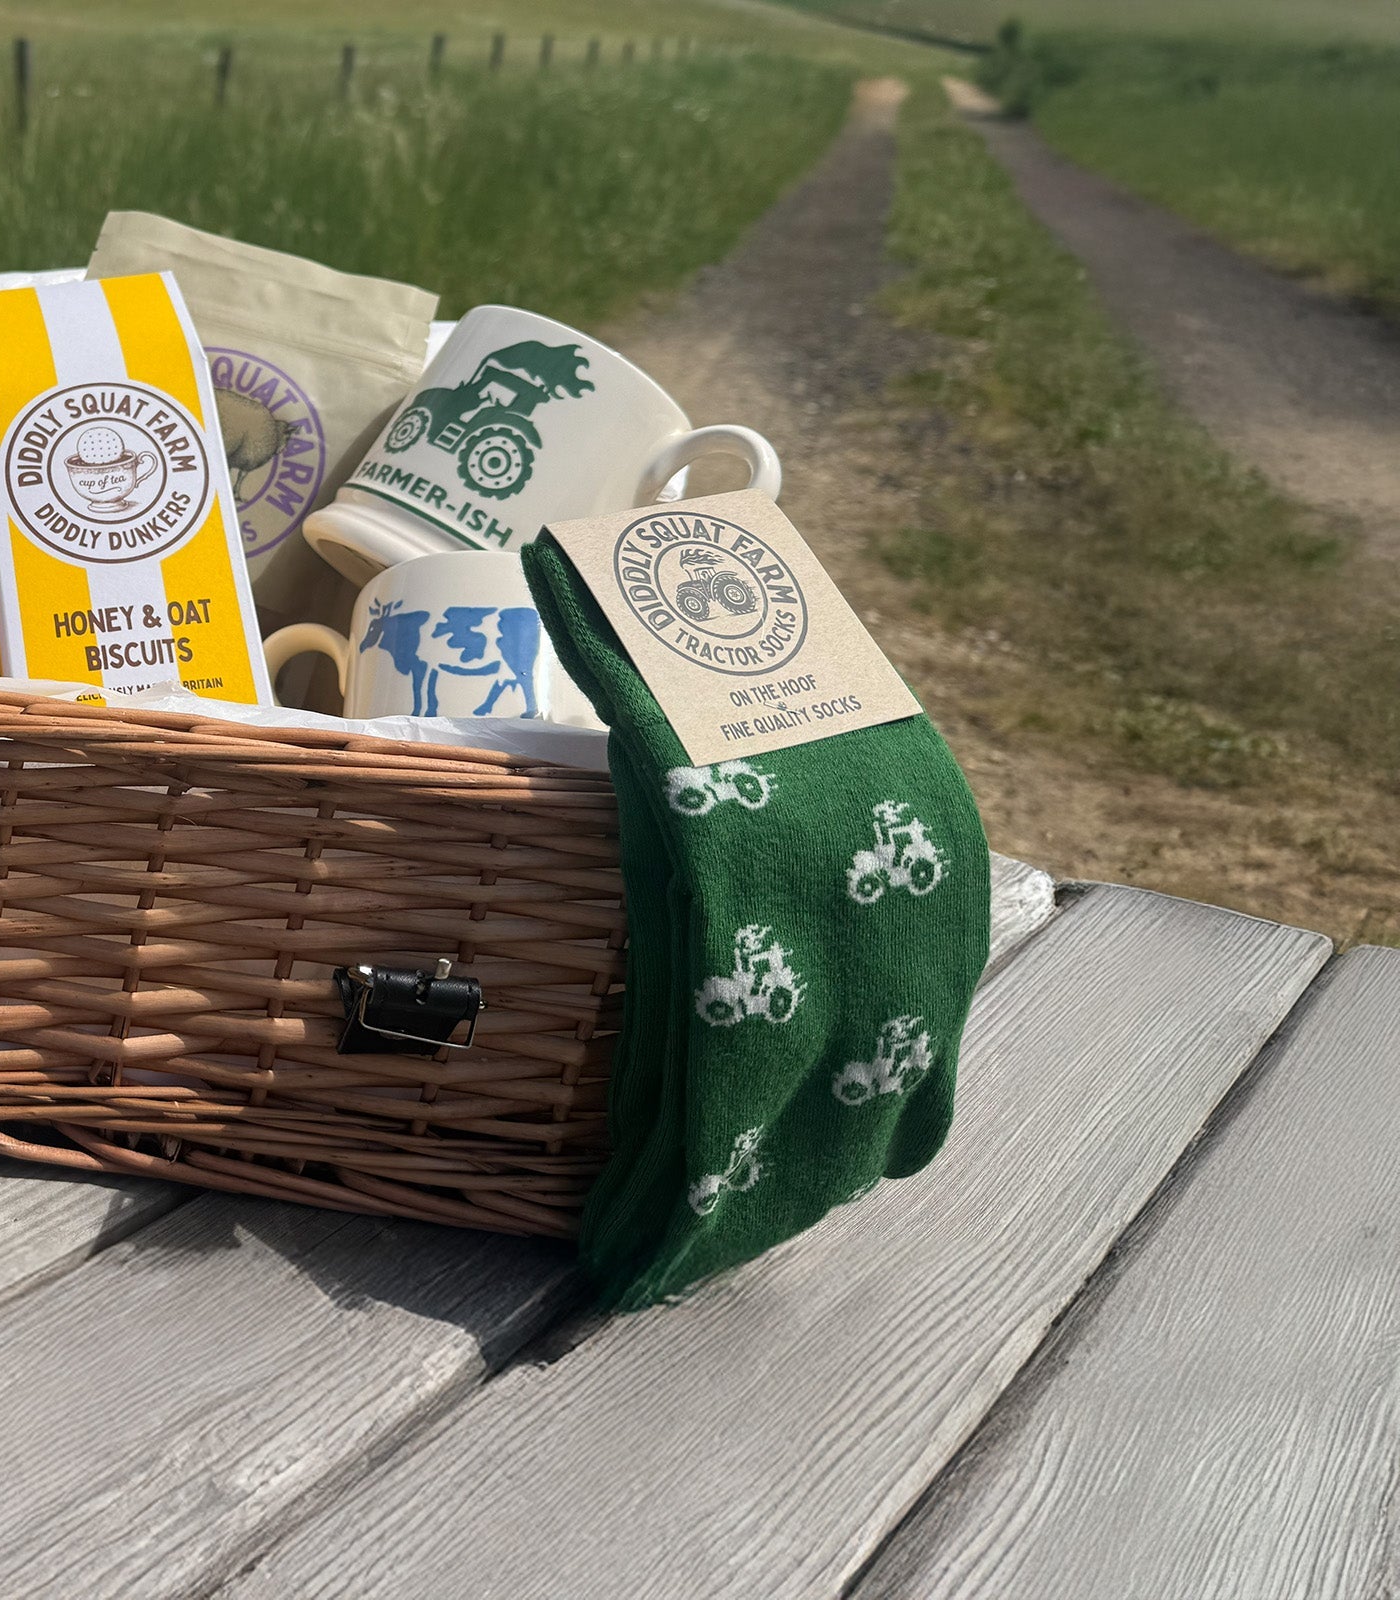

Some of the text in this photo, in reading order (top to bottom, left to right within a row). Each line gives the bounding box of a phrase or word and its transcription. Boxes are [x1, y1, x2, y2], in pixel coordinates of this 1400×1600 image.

[17, 392, 197, 487] DIDDLY SQUAT FARM
[211, 356, 315, 517] QUAT FARM
[79, 475, 127, 490] cup of tea
[355, 461, 513, 548] FARMER-ISH
[34, 490, 191, 551] DIDDLY DUNKERS
[622, 516, 798, 631] DIDDLY SQUAT FARM
[53, 599, 210, 638] HONEY & OAT
[675, 608, 796, 666] TRACTOR SOCKS
[85, 637, 193, 672] BISCUITS
[183, 677, 224, 690] BRITAIN
[729, 674, 817, 707] ON THE HOOF
[720, 694, 862, 741] FINE QUALITY SOCKS
